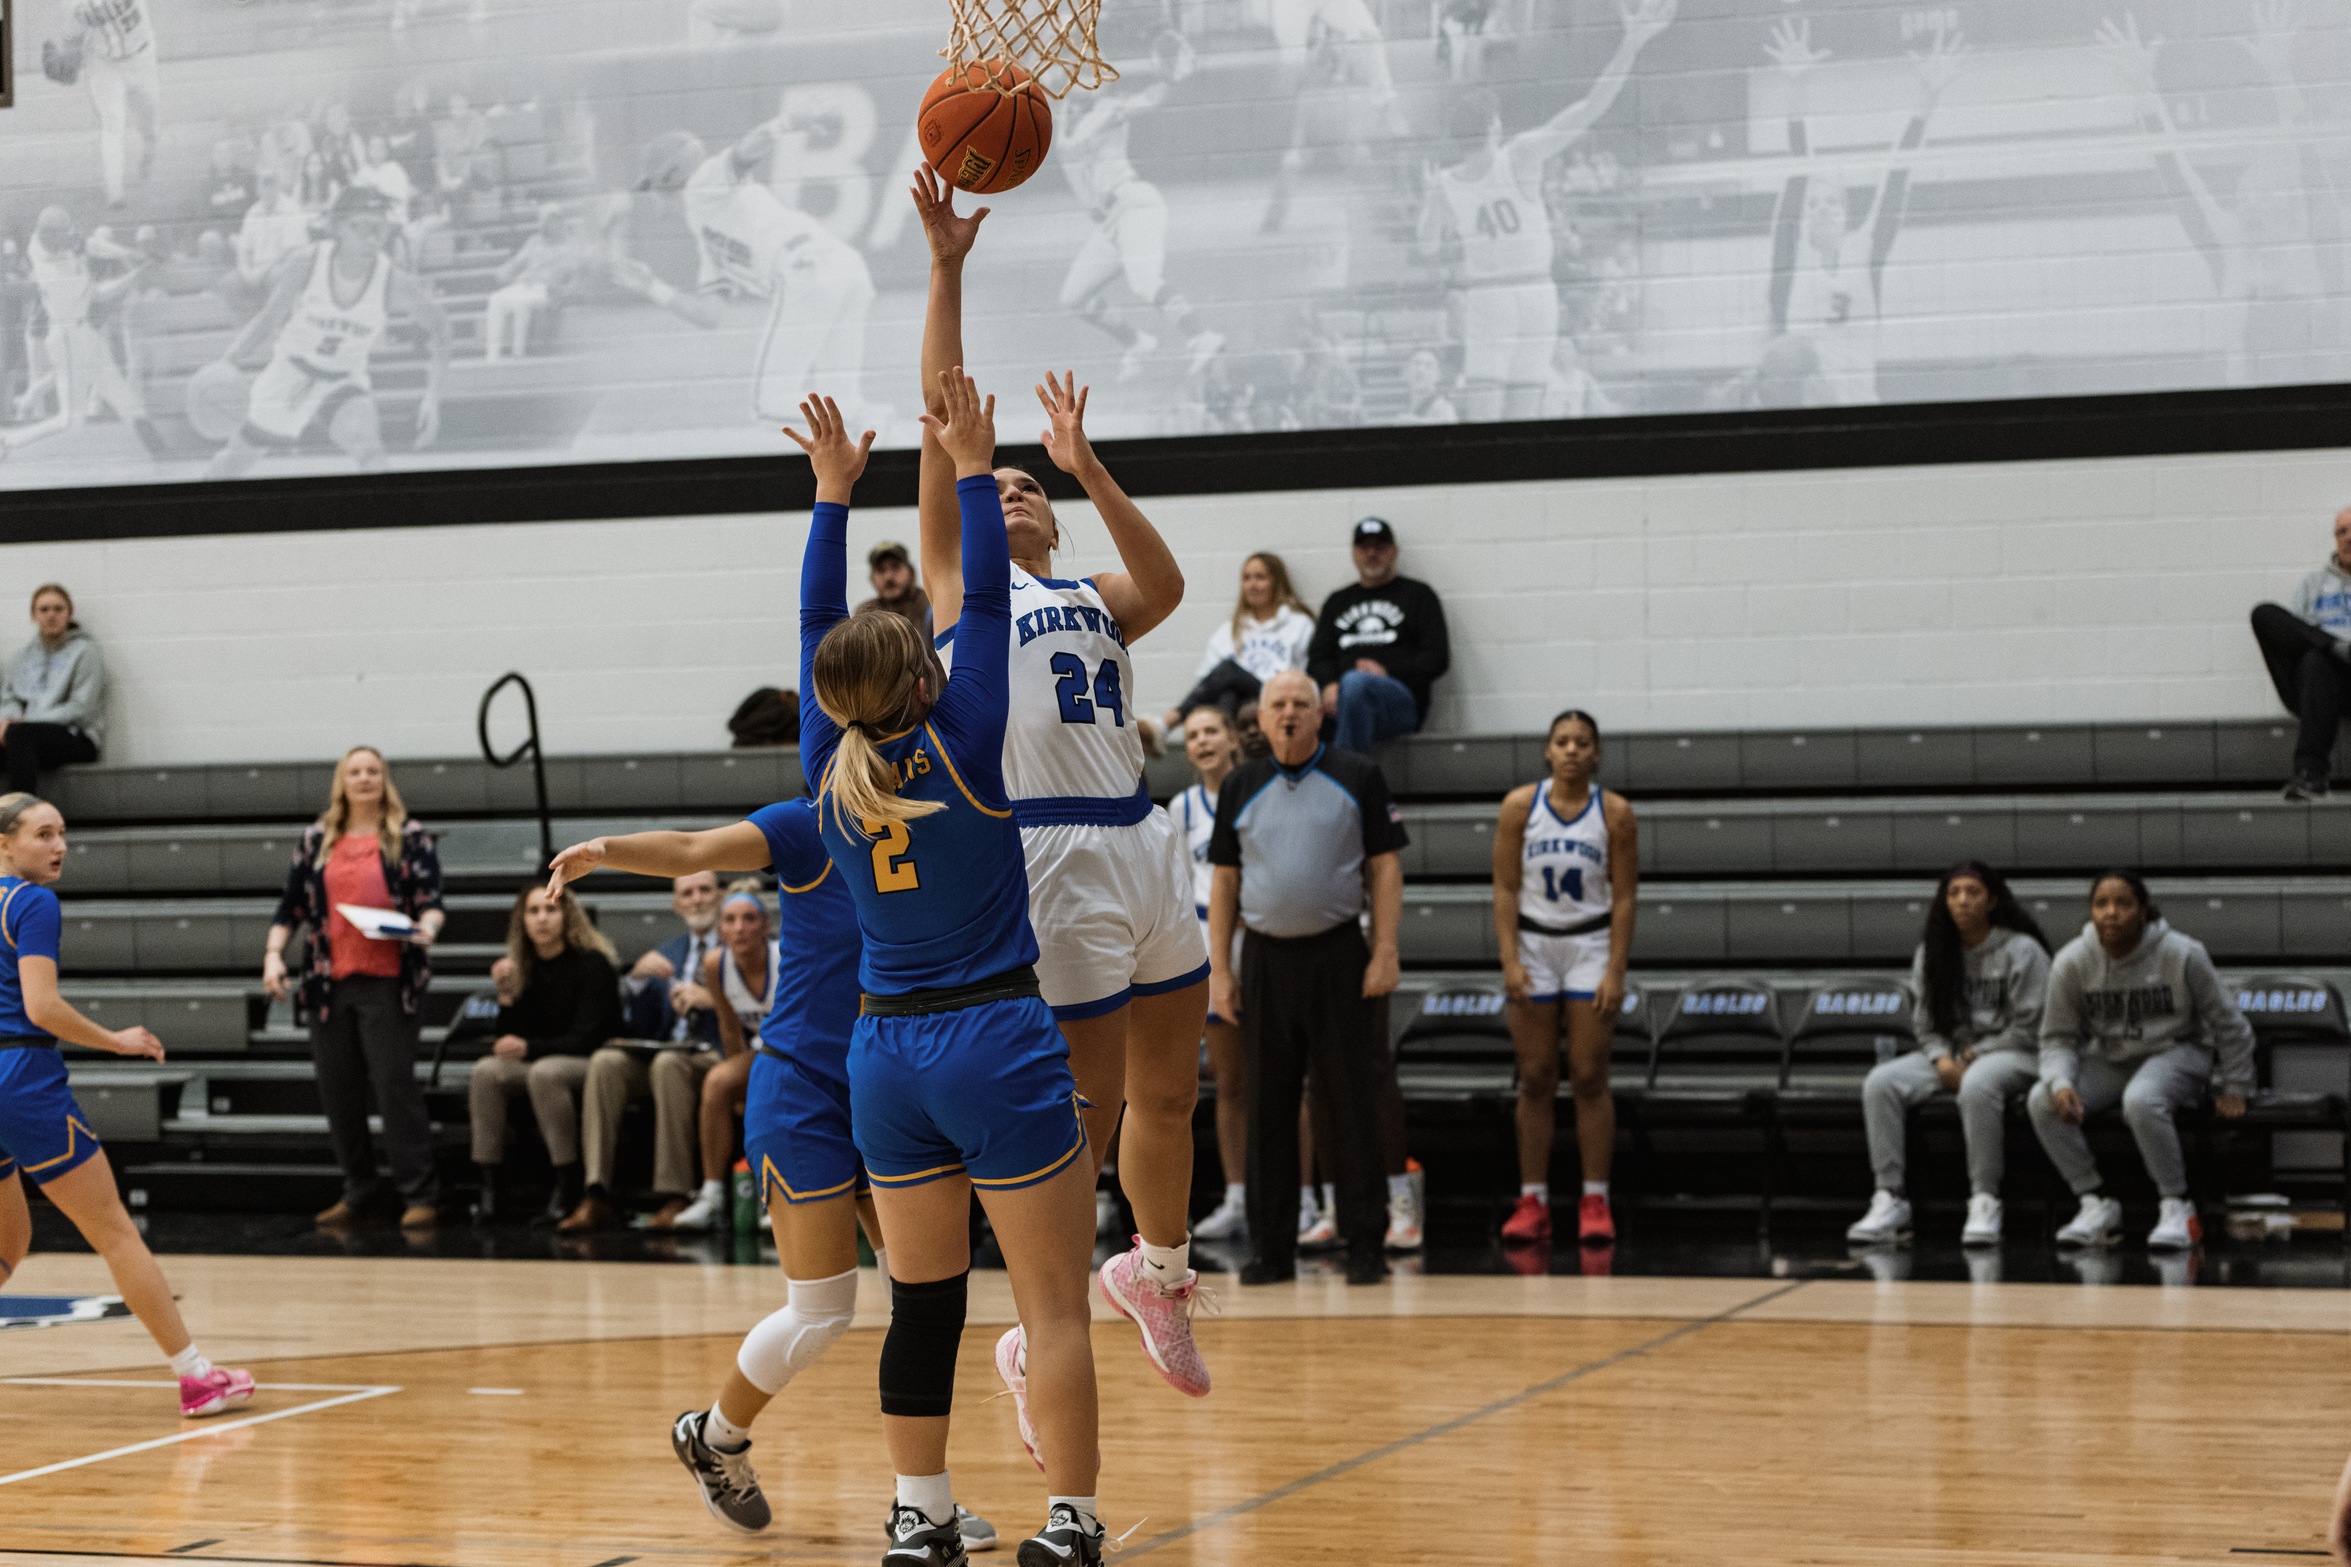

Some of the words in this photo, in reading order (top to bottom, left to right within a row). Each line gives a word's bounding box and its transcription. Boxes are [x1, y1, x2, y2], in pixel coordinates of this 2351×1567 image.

[1476, 197, 1520, 241] 40
[1049, 651, 1125, 728] 24
[861, 815, 921, 896] 2
[1542, 865, 1584, 902] 14
